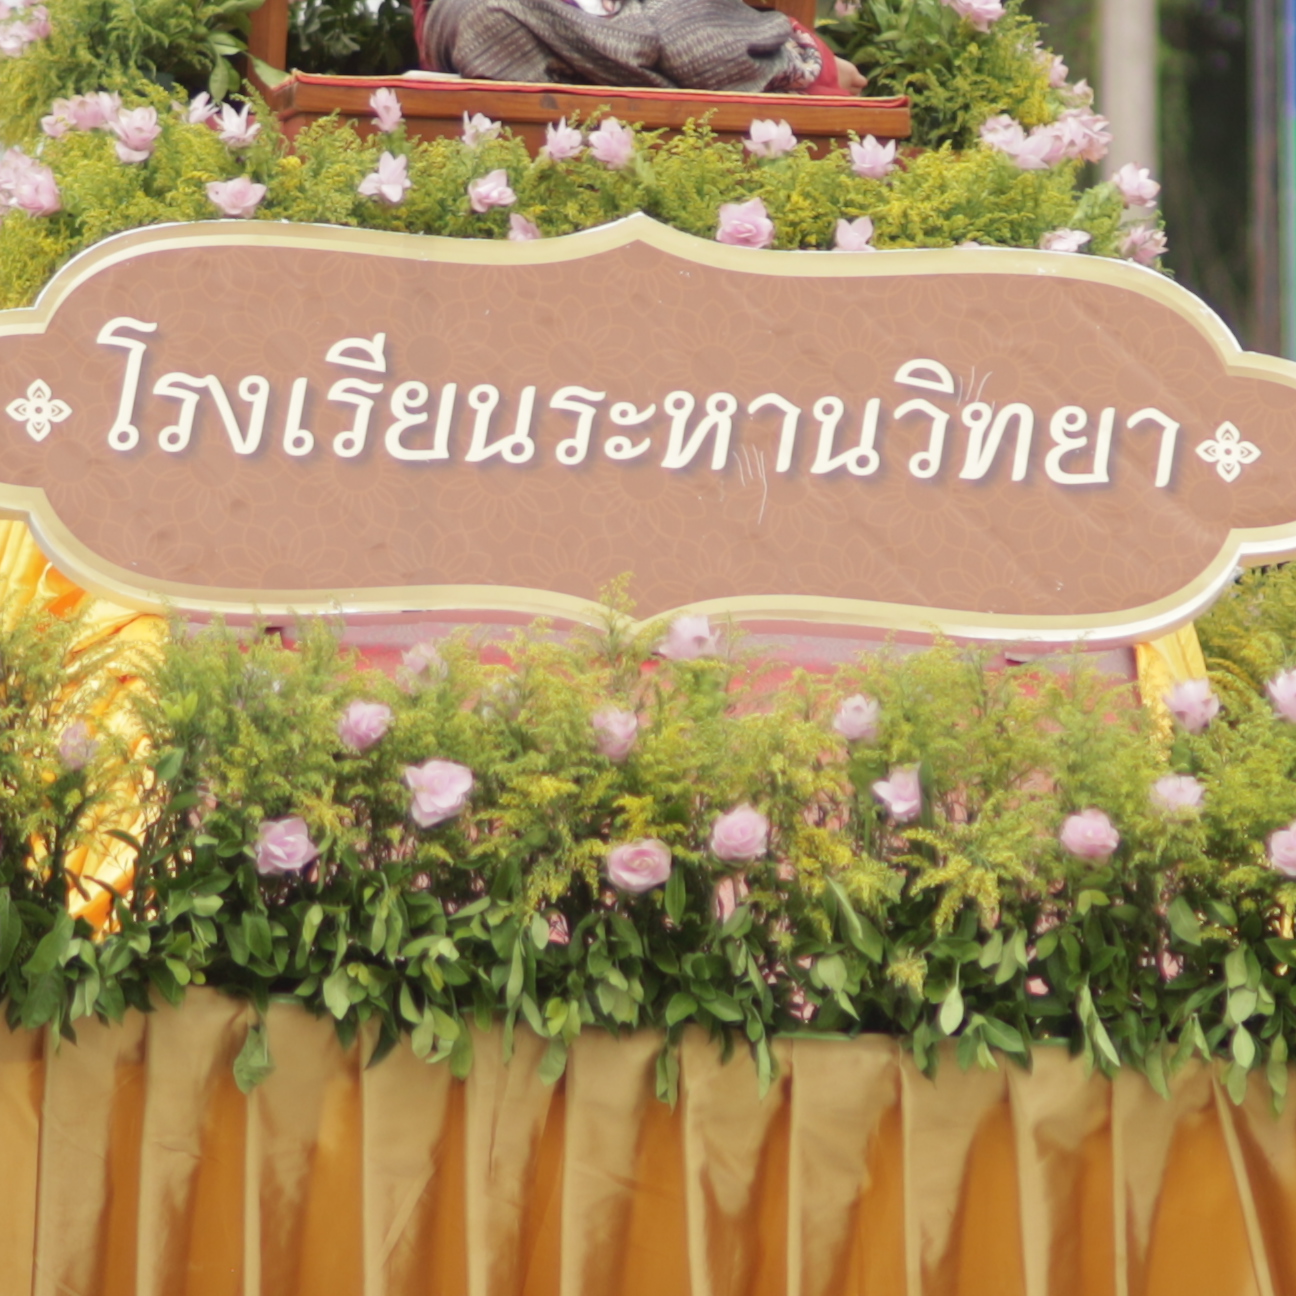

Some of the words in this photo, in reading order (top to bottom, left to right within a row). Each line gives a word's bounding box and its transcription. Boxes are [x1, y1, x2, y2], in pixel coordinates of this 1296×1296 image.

[96, 316, 1182, 489] โรงเรียนระหานวิทยา
